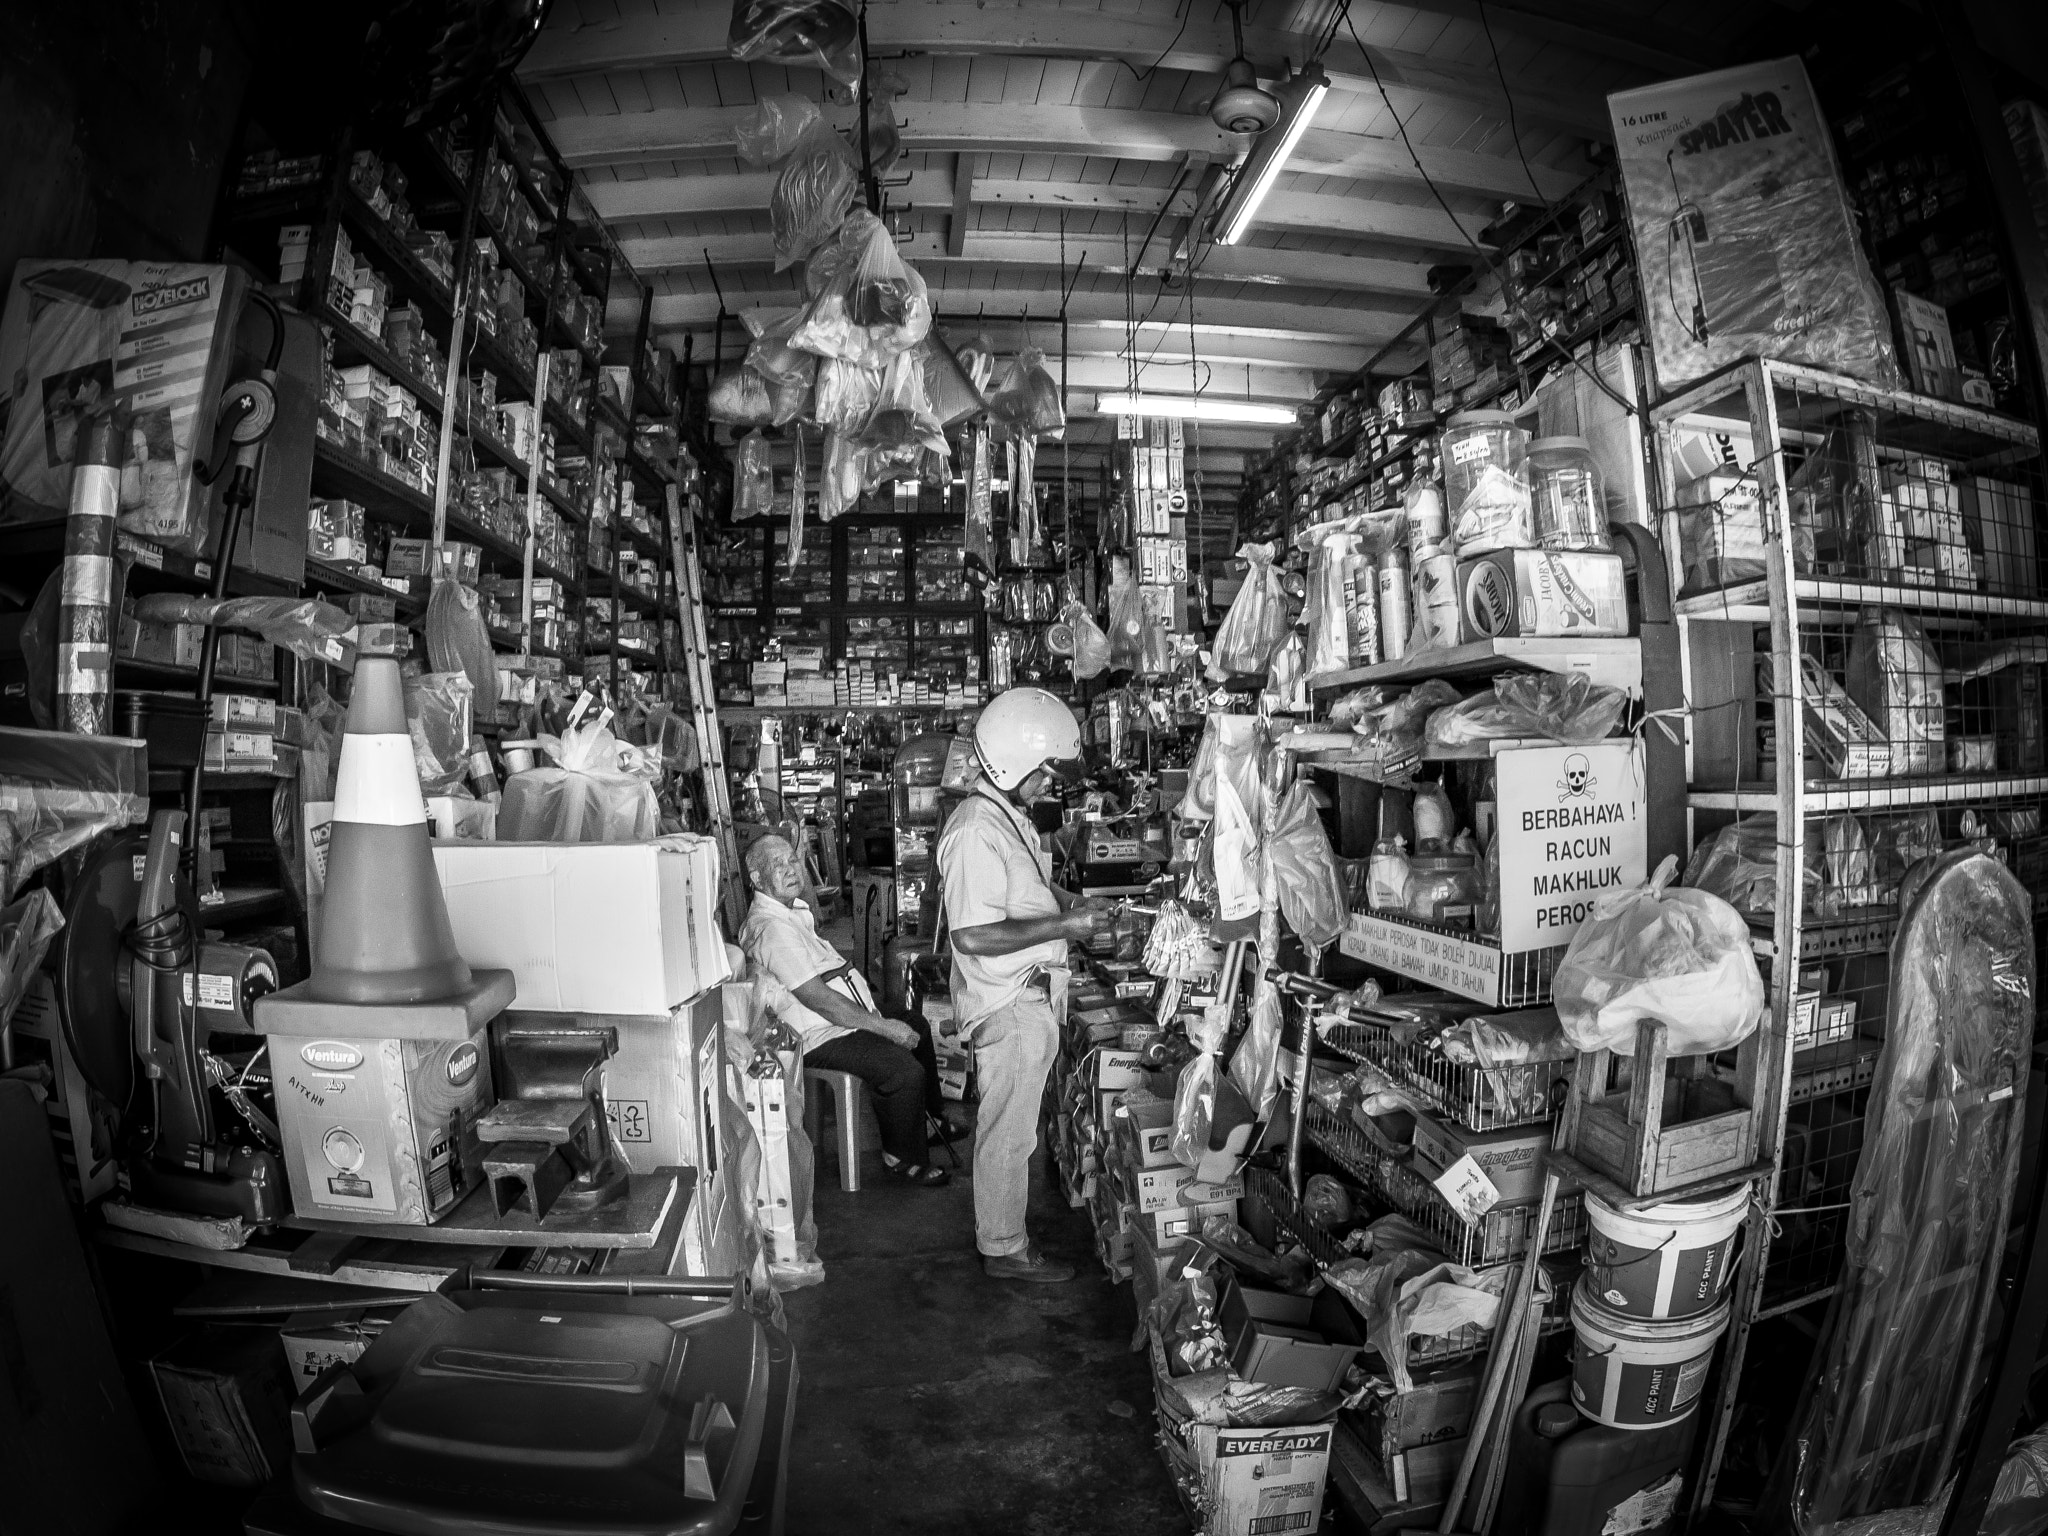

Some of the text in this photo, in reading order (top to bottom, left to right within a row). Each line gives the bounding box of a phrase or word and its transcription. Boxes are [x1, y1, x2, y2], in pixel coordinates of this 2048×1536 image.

[1621, 111, 1668, 127] 16 LITRE
[1636, 115, 1693, 147] Knapsack
[1679, 91, 1793, 156] SPRAYER
[134, 280, 207, 311] HOZELOCK
[157, 519, 179, 529] 4195
[1522, 802, 1625, 832] BERBAHAYA
[1546, 836, 1611, 862] RACUN
[1533, 865, 1622, 896] MAKHLUK
[1361, 922, 1387, 944] MAKHLUK
[1389, 928, 1418, 949] PEROSAK
[1420, 937, 1440, 957] TIDAK
[1442, 943, 1465, 965] BOLEH
[1468, 950, 1497, 975] DIJUAL
[1392, 950, 1399, 965] DI
[1401, 952, 1425, 975] BAWAH
[1428, 962, 1449, 983] UMUR
[1451, 969, 1460, 986] 18
[1461, 971, 1485, 995] TAHUN
[306, 1048, 356, 1064] Ventura
[448, 1051, 477, 1080] Ventura
[1108, 1057, 1141, 1070] Energiz
[1480, 1147, 1535, 1166] Energizer
[1145, 1196, 1157, 1205] AA
[1698, 1249, 1716, 1300] KCC PAINT
[1645, 1368, 1664, 1414] KCC PAINT
[1225, 1436, 1321, 1453] EVEREADY
